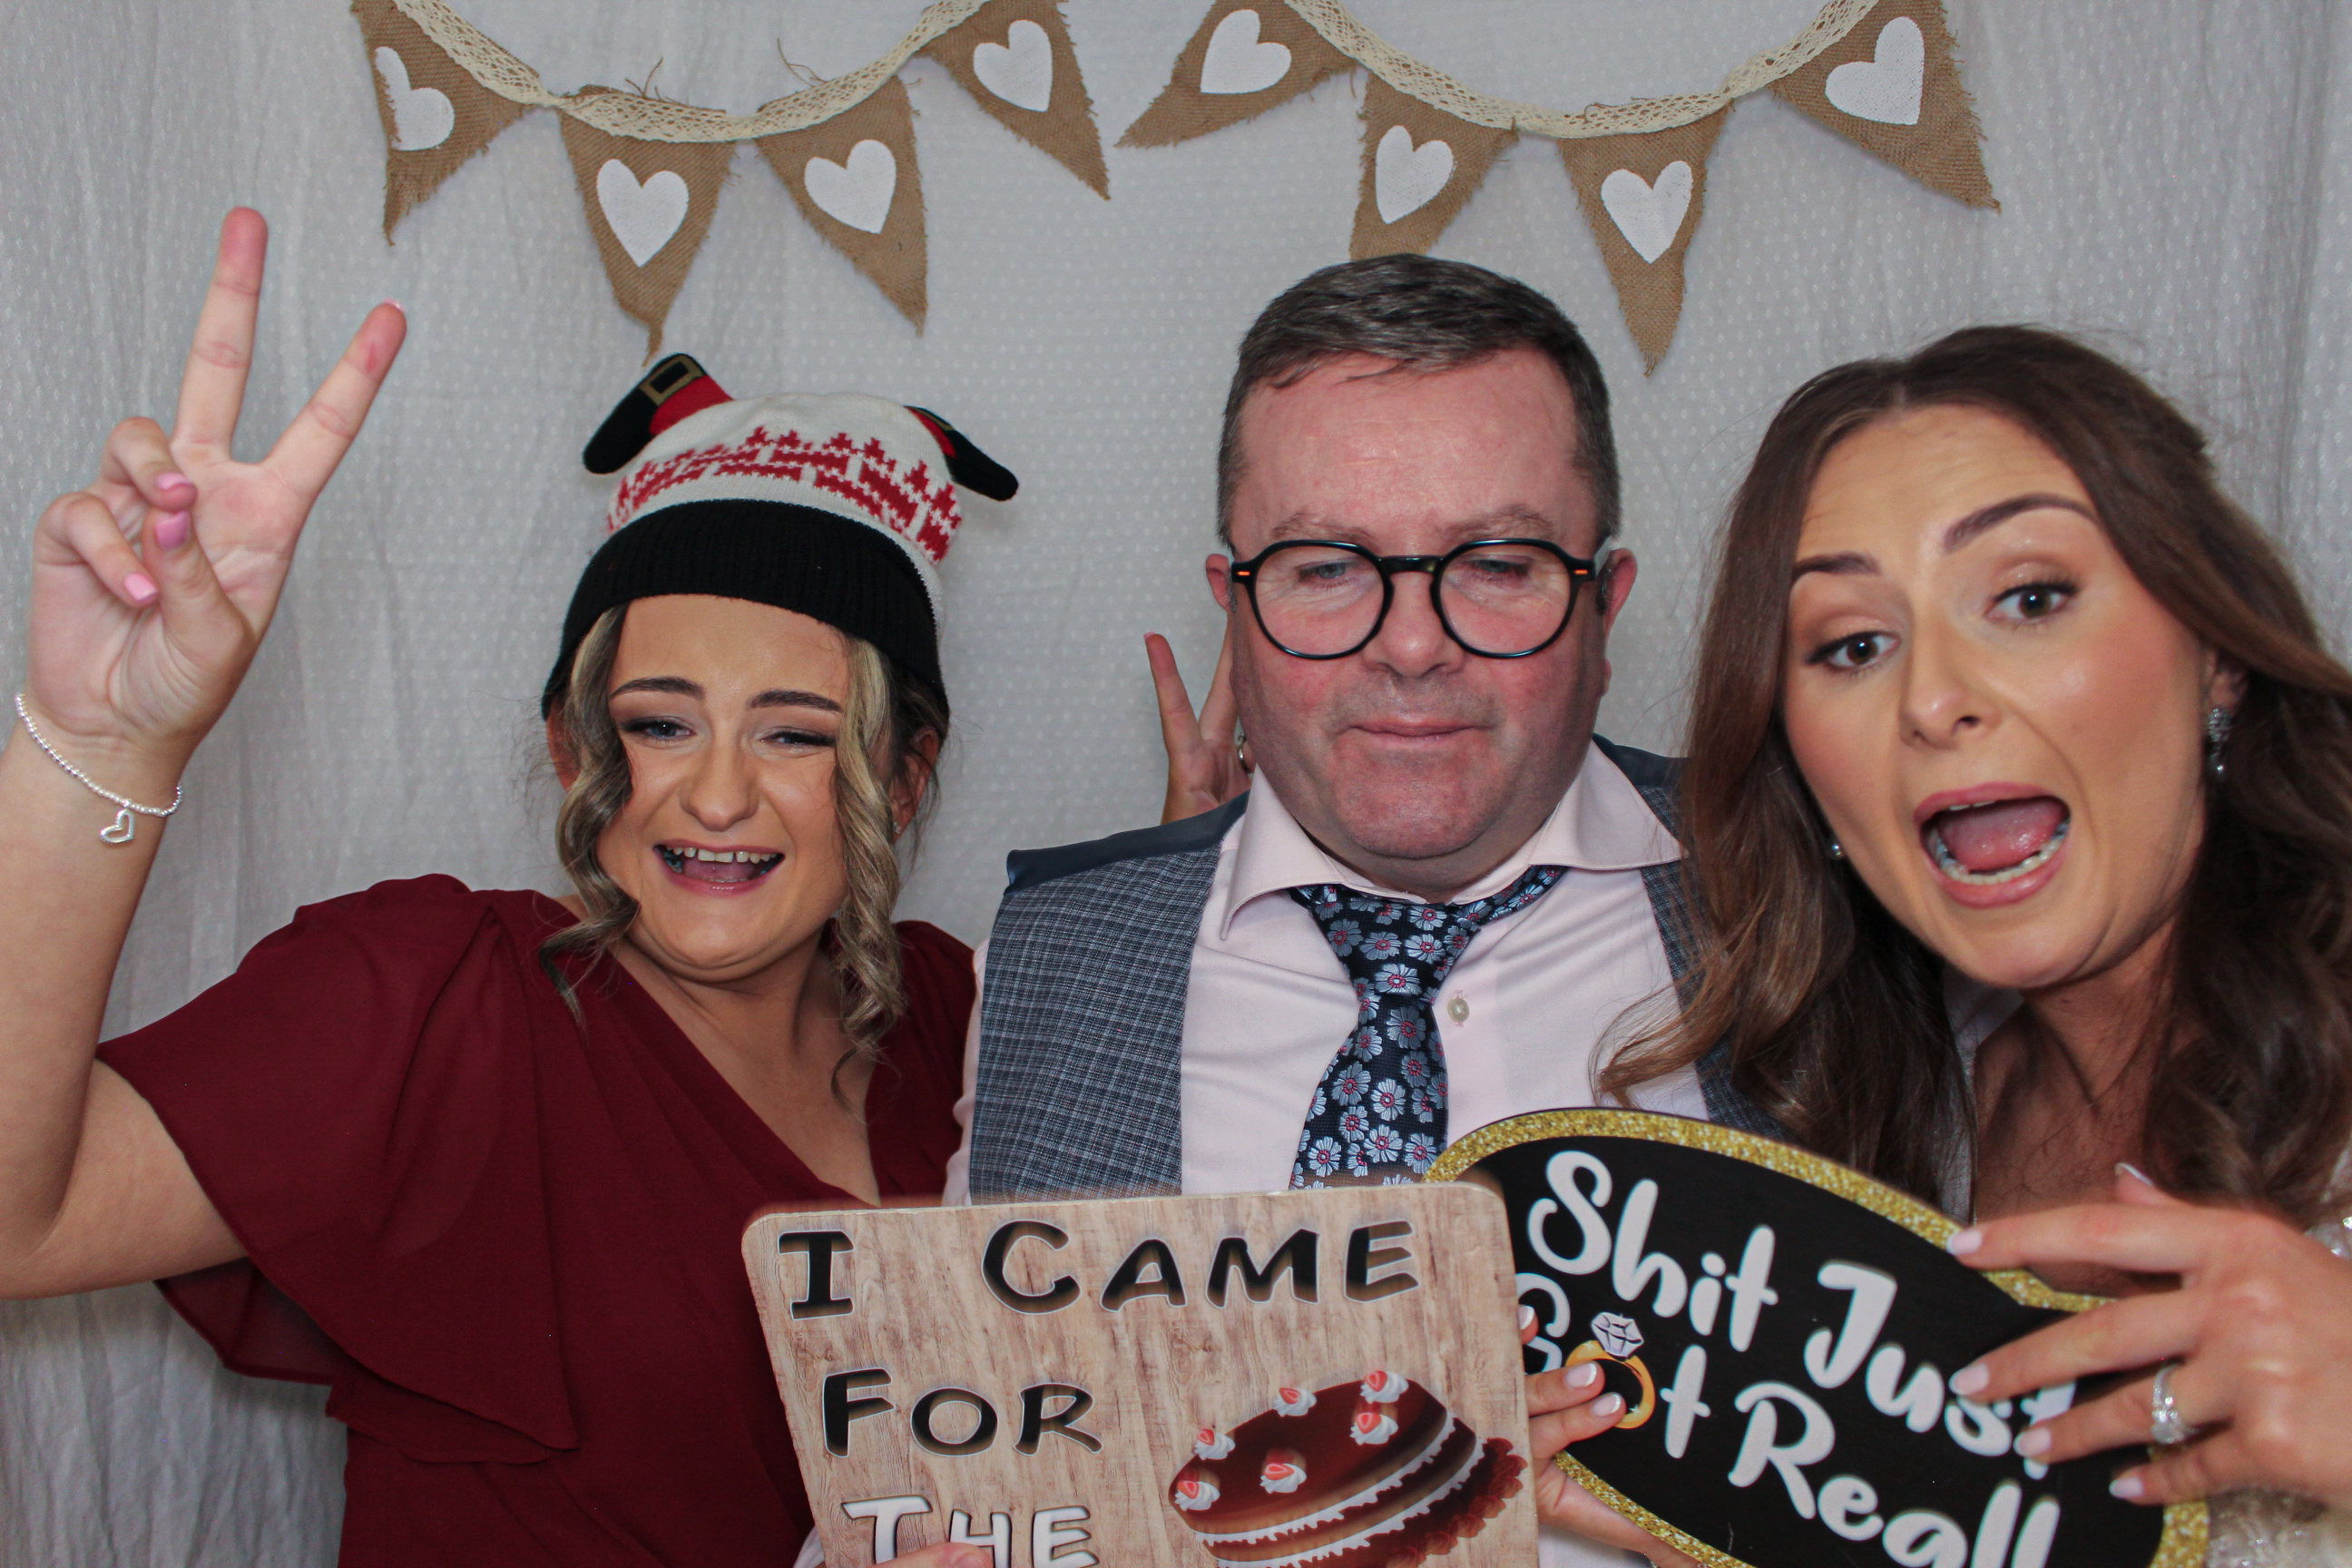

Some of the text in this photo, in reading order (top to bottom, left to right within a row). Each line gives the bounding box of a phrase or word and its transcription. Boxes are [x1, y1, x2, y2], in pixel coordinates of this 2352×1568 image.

[779, 1220, 1420, 1321] I CAME
[1527, 1150, 1779, 1353] Shit
[822, 1368, 1103, 1458] FOR
[840, 1494, 1101, 1568] THE
